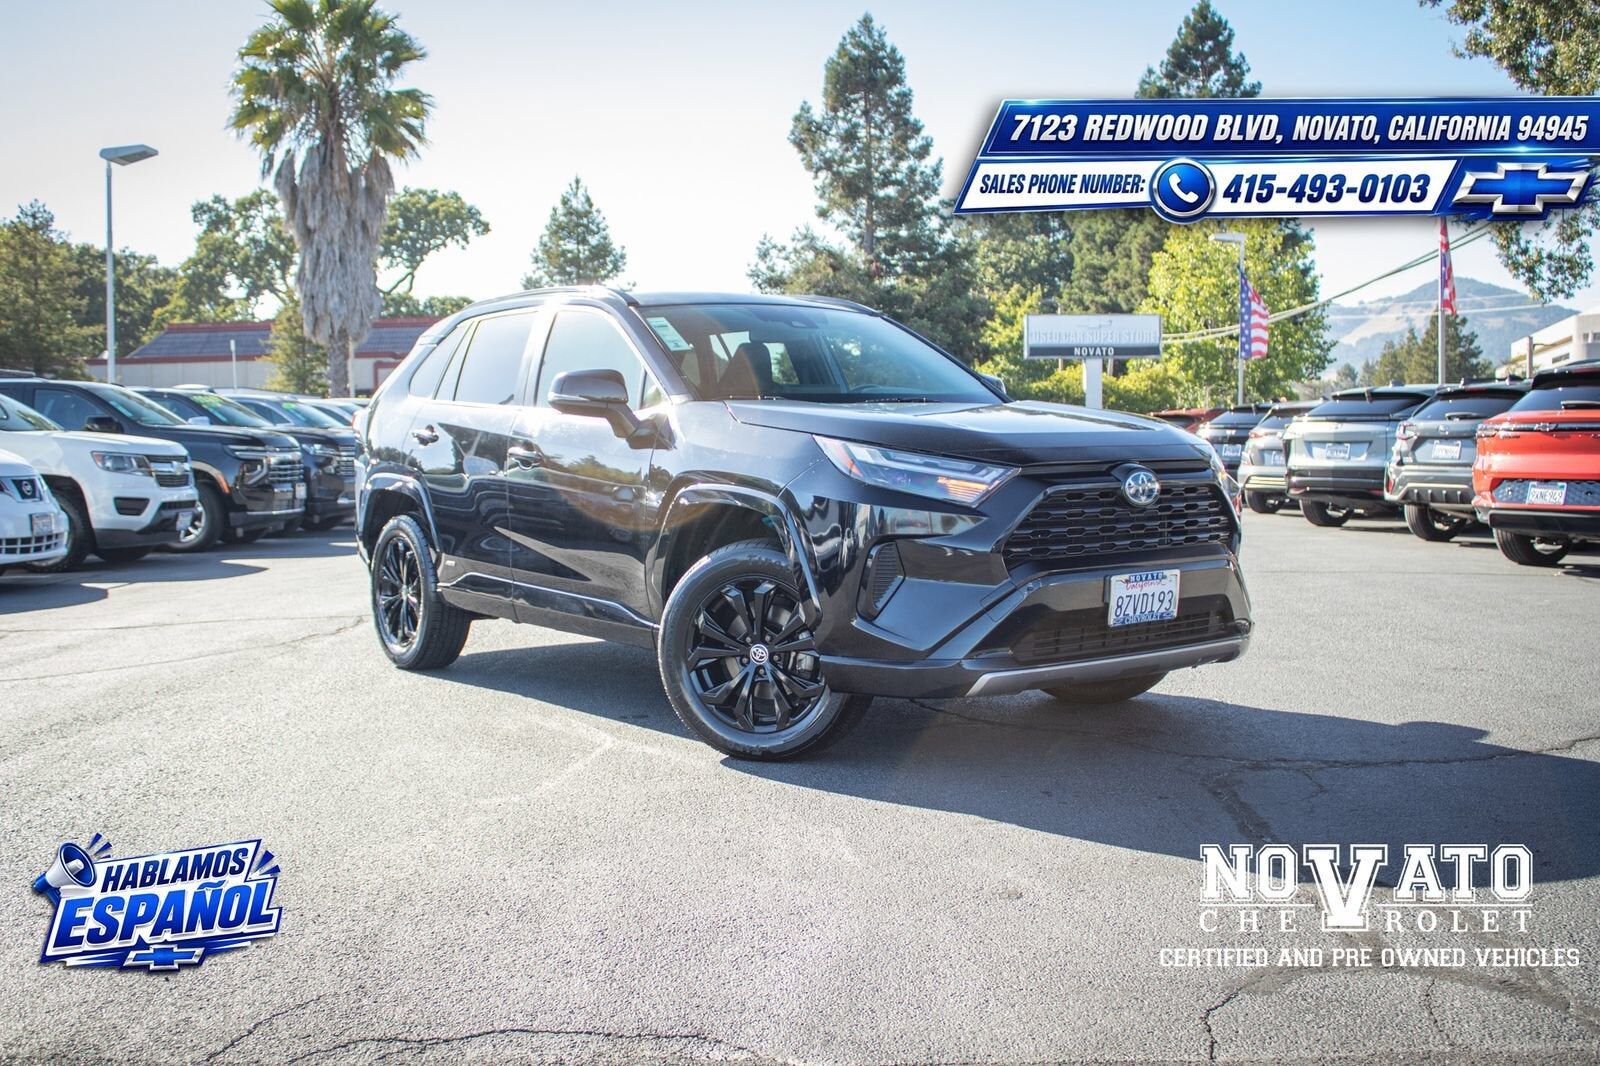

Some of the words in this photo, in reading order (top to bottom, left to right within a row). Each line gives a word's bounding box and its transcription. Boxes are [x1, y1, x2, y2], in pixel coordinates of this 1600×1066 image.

[1087, 330, 1121, 343] SUPER
[1123, 330, 1158, 343] STORE
[1073, 347, 1115, 356] NOVATO
[1130, 573, 1163, 582] NOVATO
[1114, 590, 1174, 617] 8ZVD193
